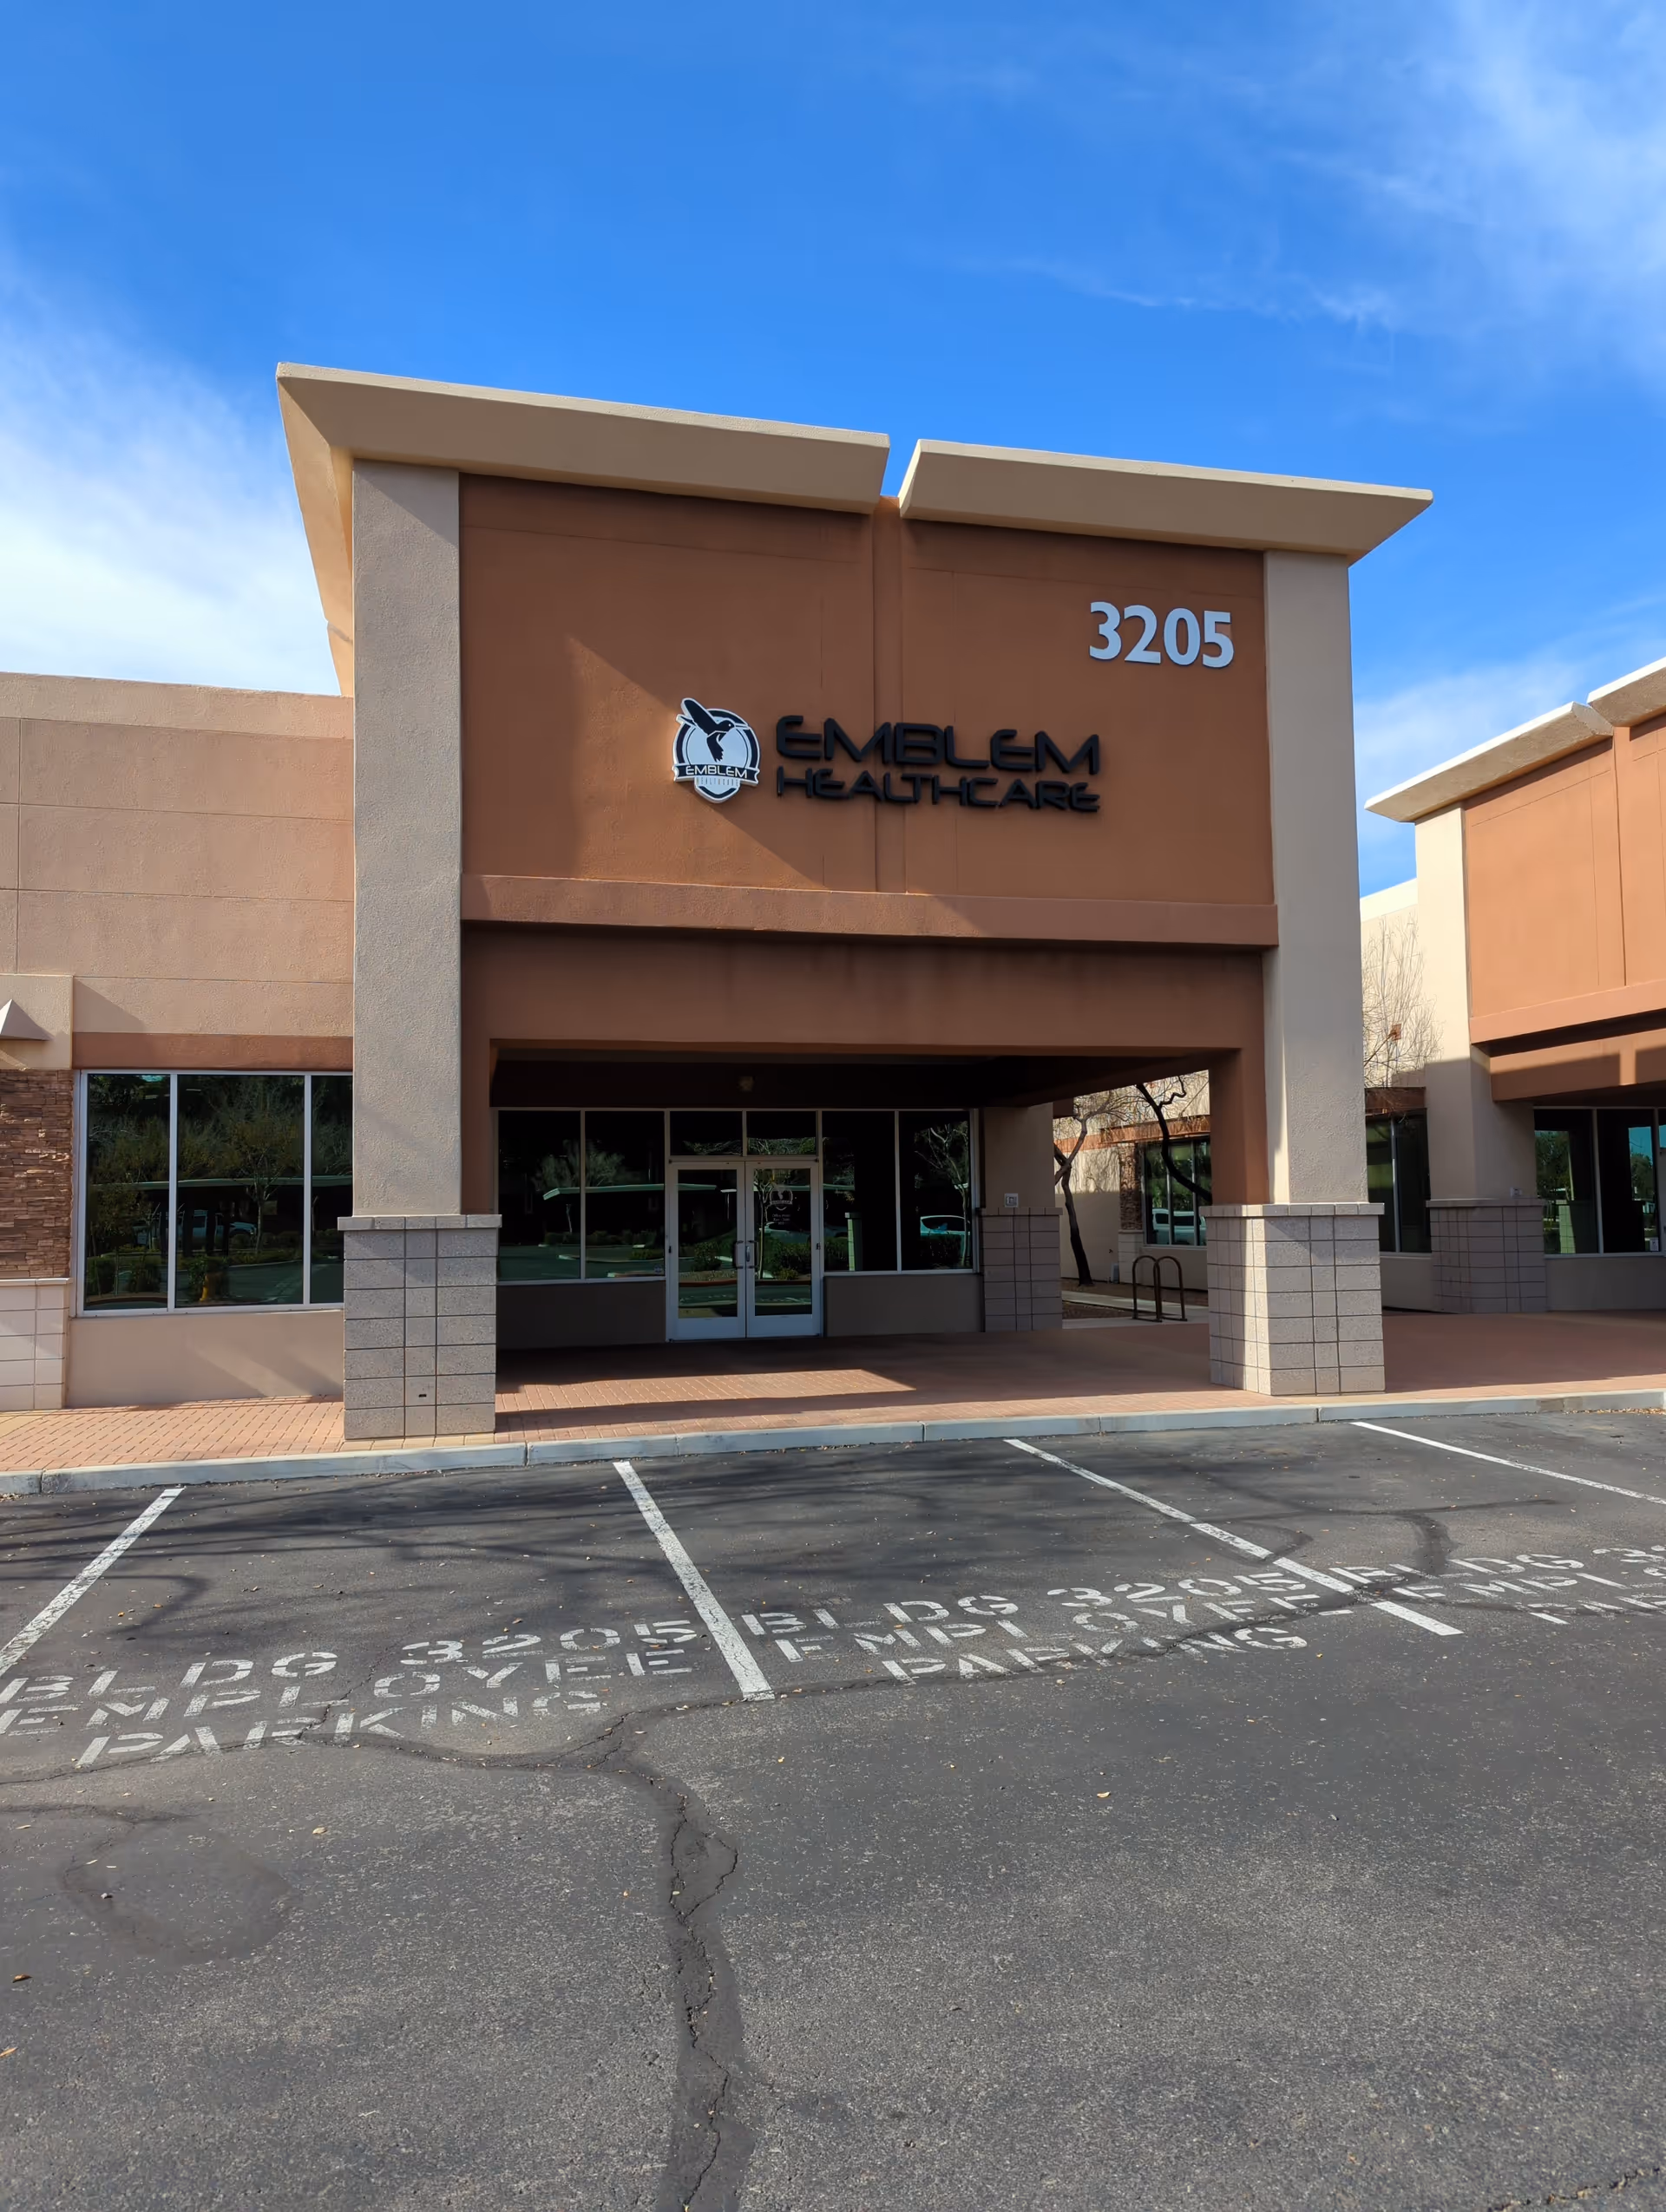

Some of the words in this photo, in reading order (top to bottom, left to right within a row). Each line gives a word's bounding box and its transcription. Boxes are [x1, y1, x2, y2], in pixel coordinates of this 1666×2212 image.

[1089, 601, 1235, 668] 3205
[685, 766, 747, 779] EMBLEM
[777, 714, 1100, 775] EMBLEM
[777, 766, 1100, 812] HEALTHCARE
[1329, 1554, 1584, 1585] BLDG
[743, 1594, 1019, 1635] BLDG
[1047, 1572, 1306, 1608] 3205
[776, 1594, 1354, 1663] EMPLOYEE
[0, 1651, 338, 1703] BLDG
[400, 1620, 697, 1666] 3205
[882, 1626, 1308, 1685] PARKING
[0, 1648, 693, 1736] EMPLOYEE
[75, 1692, 601, 1769] PARKING
